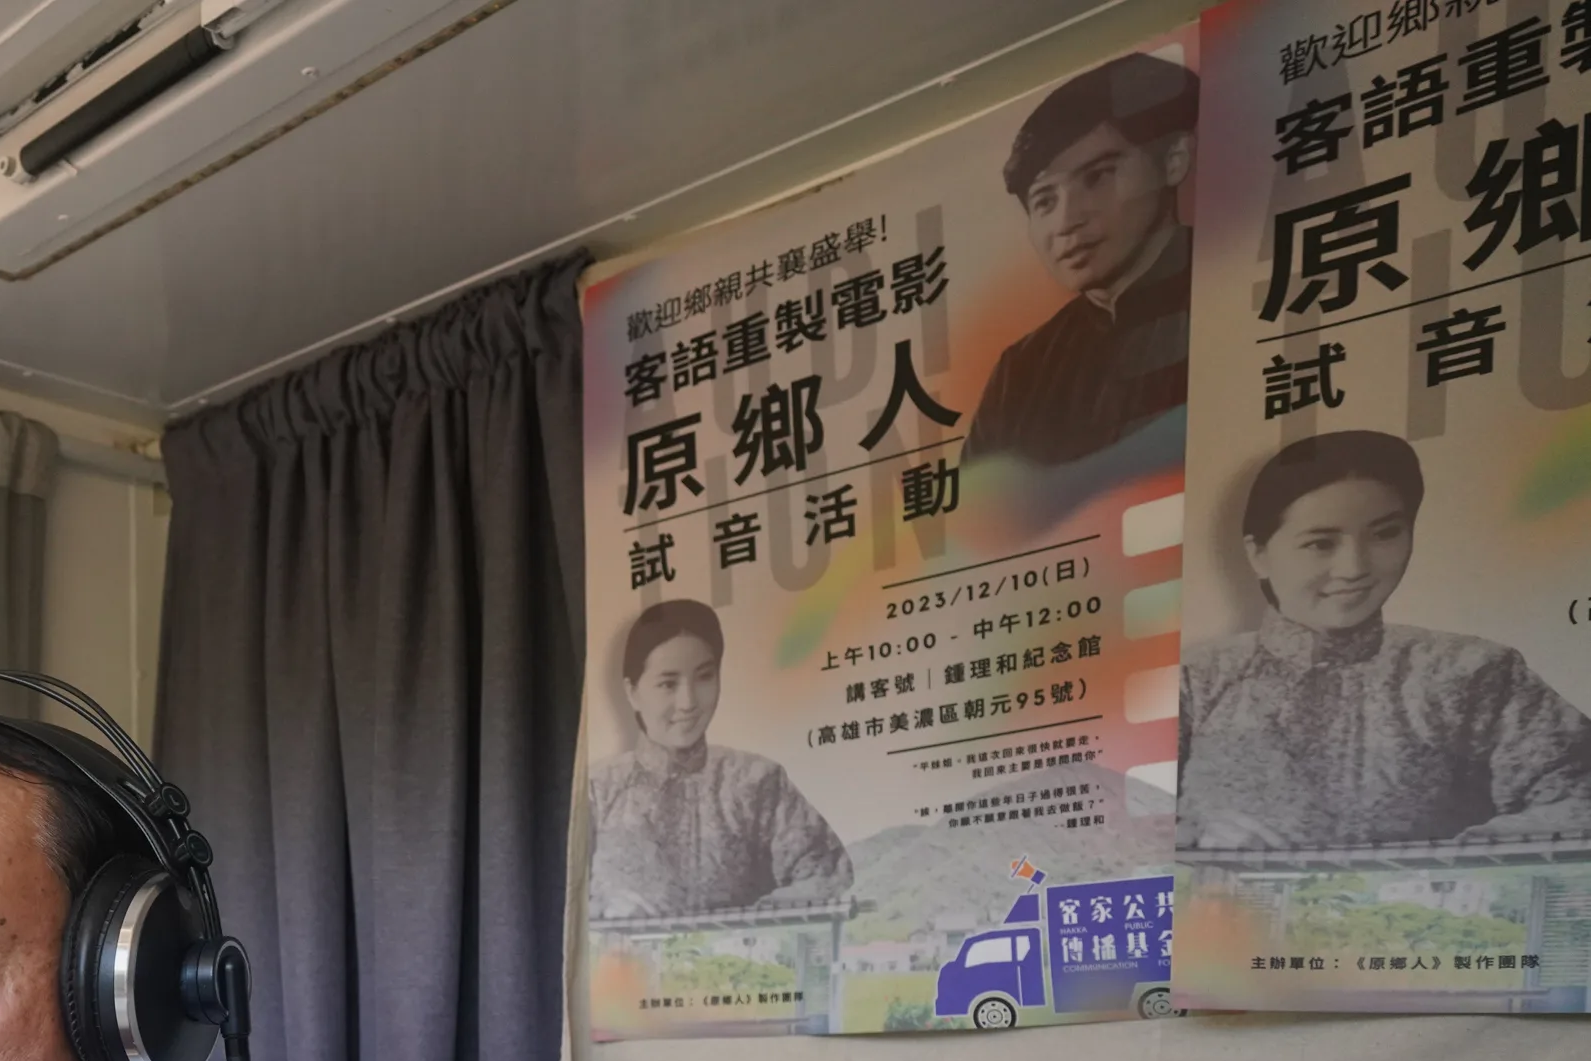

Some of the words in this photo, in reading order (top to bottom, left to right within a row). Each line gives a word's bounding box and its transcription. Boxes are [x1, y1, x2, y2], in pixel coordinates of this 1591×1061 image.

[623, 245, 951, 408] 客語重製電影
[622, 338, 964, 516] 原鄉人
[629, 460, 961, 590] 試音活動
[885, 556, 1090, 620] 2023/12/10(日)
[821, 632, 937, 672] 上午10:00
[973, 596, 1102, 642] 中午12:00
[1124, 920, 1154, 930] PUBLIC
[1062, 961, 1139, 973] COMMUNICATION
